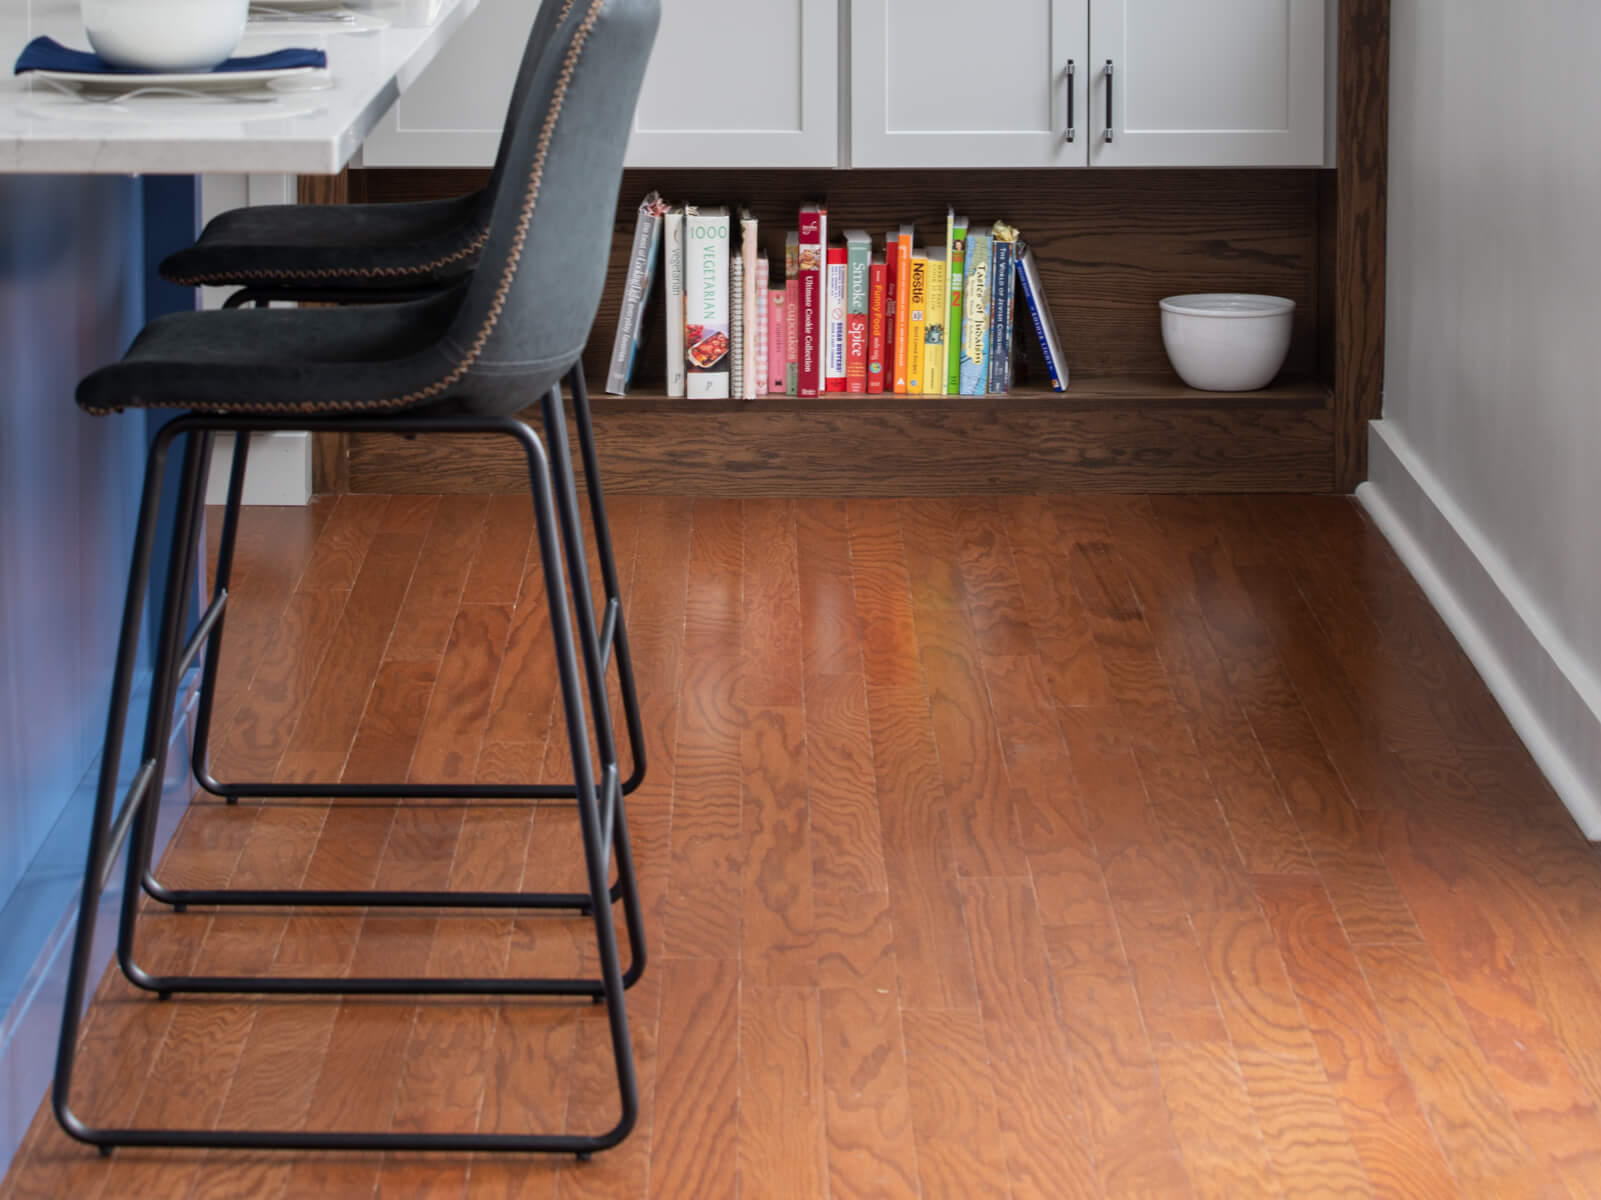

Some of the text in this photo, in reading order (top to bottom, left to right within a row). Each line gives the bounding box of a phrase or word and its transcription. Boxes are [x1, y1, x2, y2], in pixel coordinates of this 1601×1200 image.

[690, 225, 728, 240] 1000
[671, 248, 681, 296] vegetarian
[703, 245, 716, 320] VEGETARIAN
[852, 262, 865, 308] Smoke
[872, 284, 883, 312] Funny
[952, 291, 960, 307] 2
[974, 264, 986, 364] Tastes of Judaism
[804, 275, 814, 373] Ultimate Cookie Collection
[848, 322, 865, 357] Spice
[873, 312, 882, 336] Food
